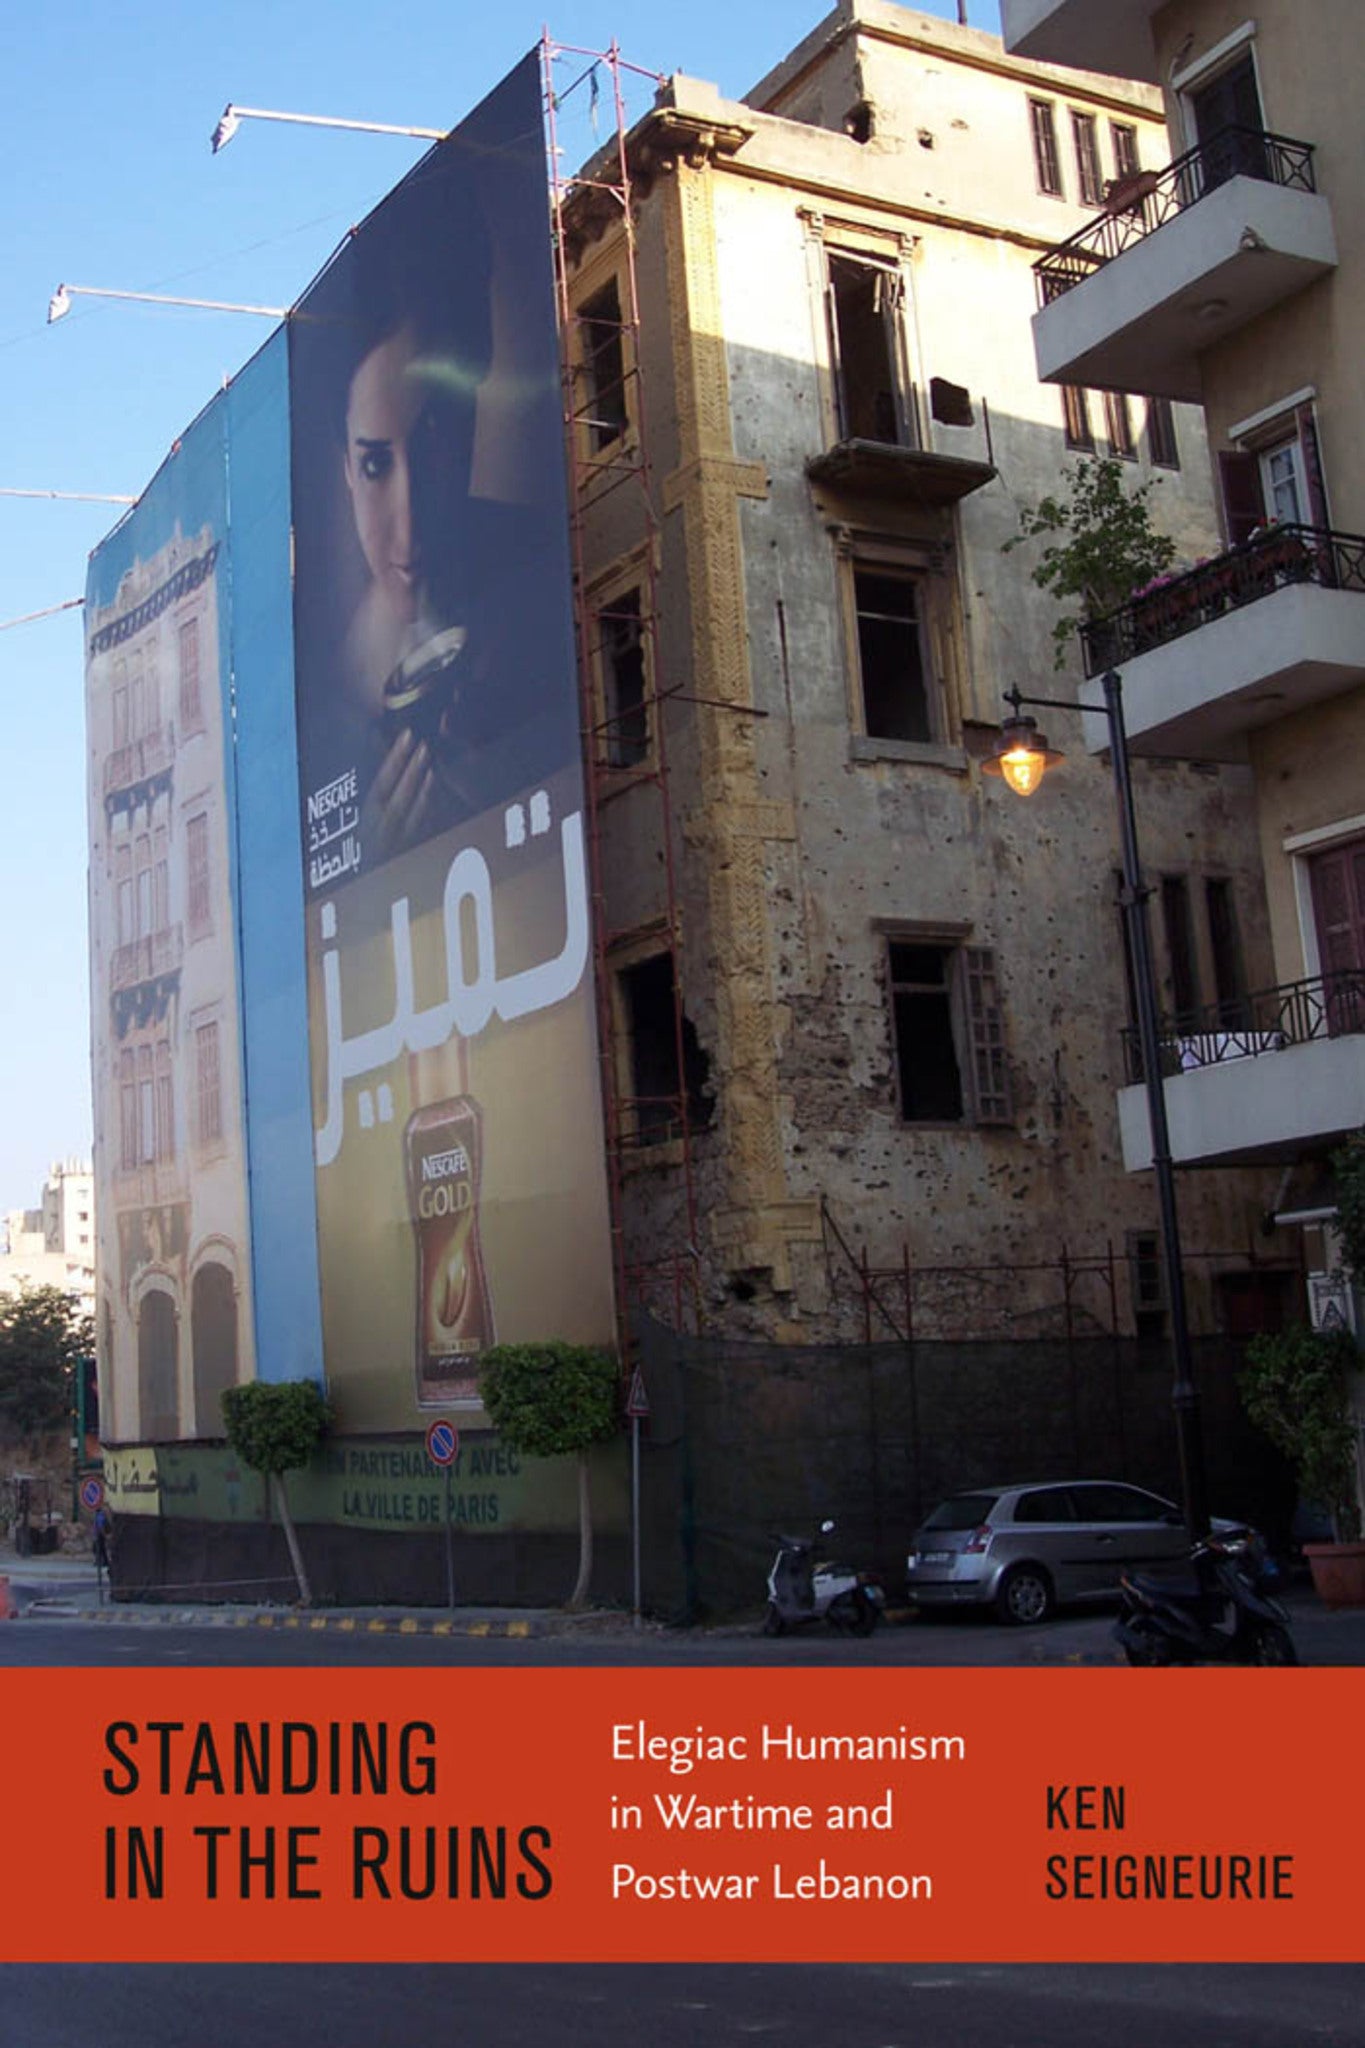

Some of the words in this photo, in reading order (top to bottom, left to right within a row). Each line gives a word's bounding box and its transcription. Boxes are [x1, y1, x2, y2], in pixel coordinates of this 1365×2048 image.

[315, 789, 589, 1167] تميز
[419, 1181, 472, 1219] GOLD
[470, 1447, 521, 1476] AVEC
[343, 1490, 363, 1517] LA
[365, 1491, 415, 1522] VILLE
[417, 1495, 440, 1523] DE
[447, 1494, 499, 1523] PARIS
